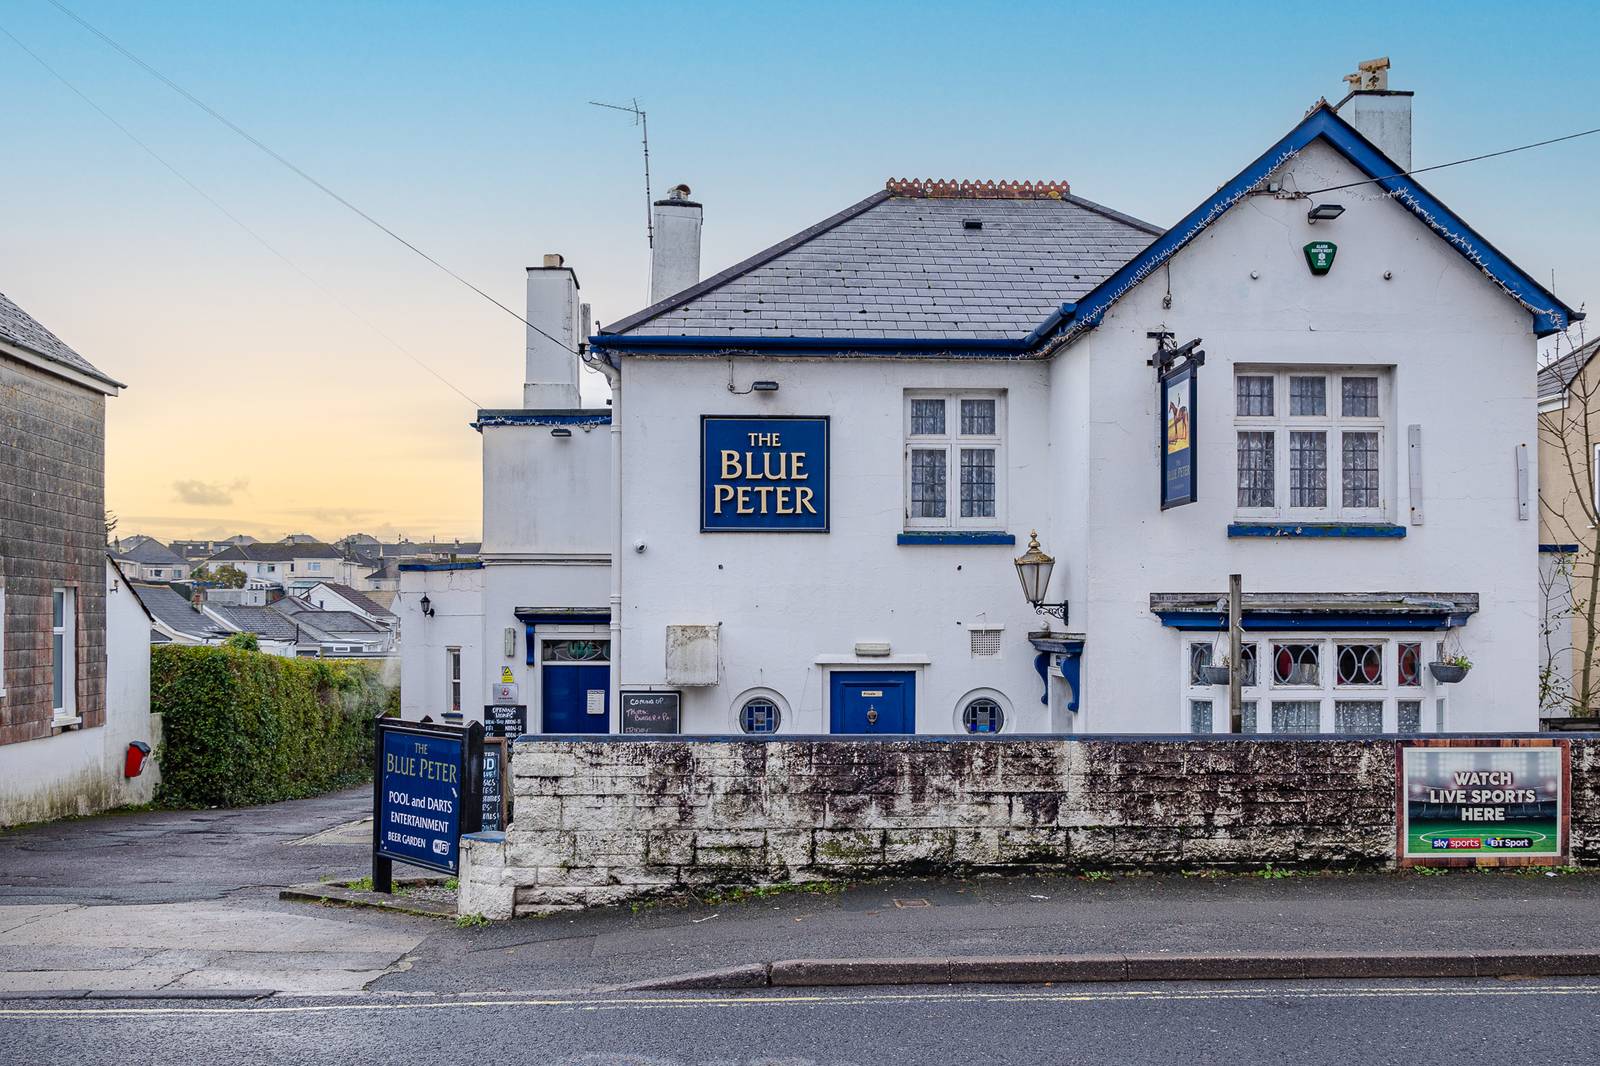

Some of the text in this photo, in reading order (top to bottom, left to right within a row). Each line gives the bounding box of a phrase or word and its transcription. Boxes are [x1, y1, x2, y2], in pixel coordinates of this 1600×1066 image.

[748, 433, 781, 447] THE
[720, 450, 808, 480] BLUE
[713, 484, 817, 514] PETER
[414, 742, 428, 755] THE
[387, 753, 457, 784] BLUE PETER
[1454, 771, 1512, 786] WATCH
[388, 790, 453, 814] POOL and DARTS
[1429, 789, 1536, 804] LIVE SPORTS
[1461, 807, 1506, 821] HERE
[390, 811, 449, 833] ENTERTAINMENT
[387, 831, 426, 848] BEER GARDEN
[1433, 839, 1480, 849] sky sports
[1491, 839, 1529, 848] BT Sport
